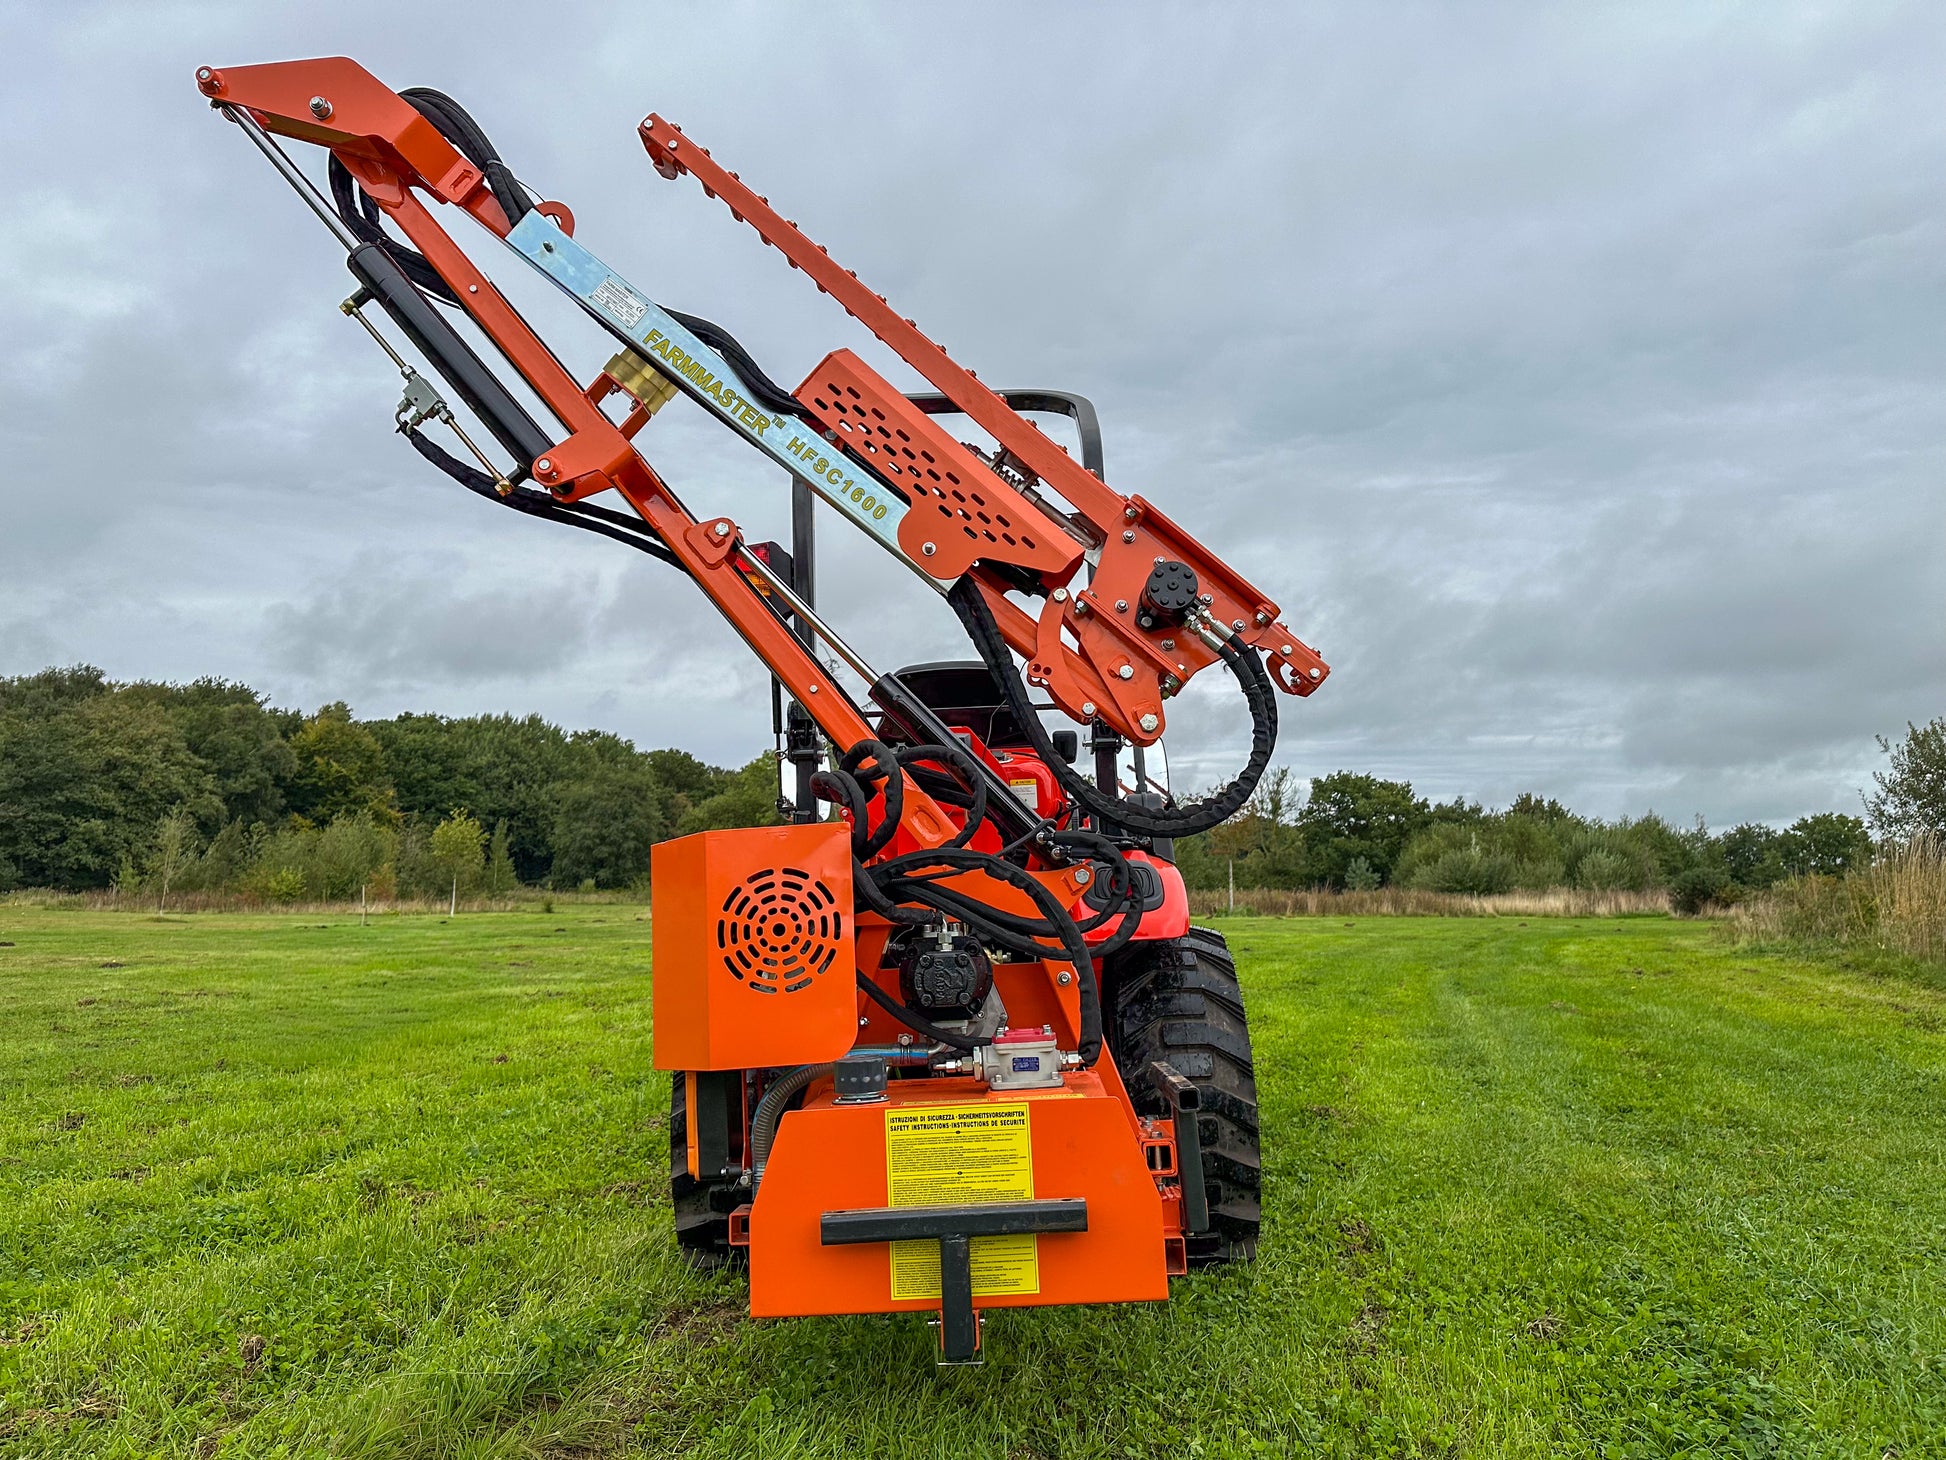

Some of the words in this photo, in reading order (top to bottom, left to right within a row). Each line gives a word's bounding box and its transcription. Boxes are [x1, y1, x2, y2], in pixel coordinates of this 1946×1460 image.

[642, 328, 771, 437] FARMMASTER
[785, 435, 888, 520] HFSC1600
[889, 1116, 918, 1124] ISTRUZIONI
[927, 1114, 955, 1122] SICUREZZA
[889, 1124, 909, 1132] SAFETY
[911, 1122, 950, 1131] INSTRUCTIONS
[951, 1119, 990, 1128] INSTRUCTIONS
[991, 1119, 998, 1127] DE
